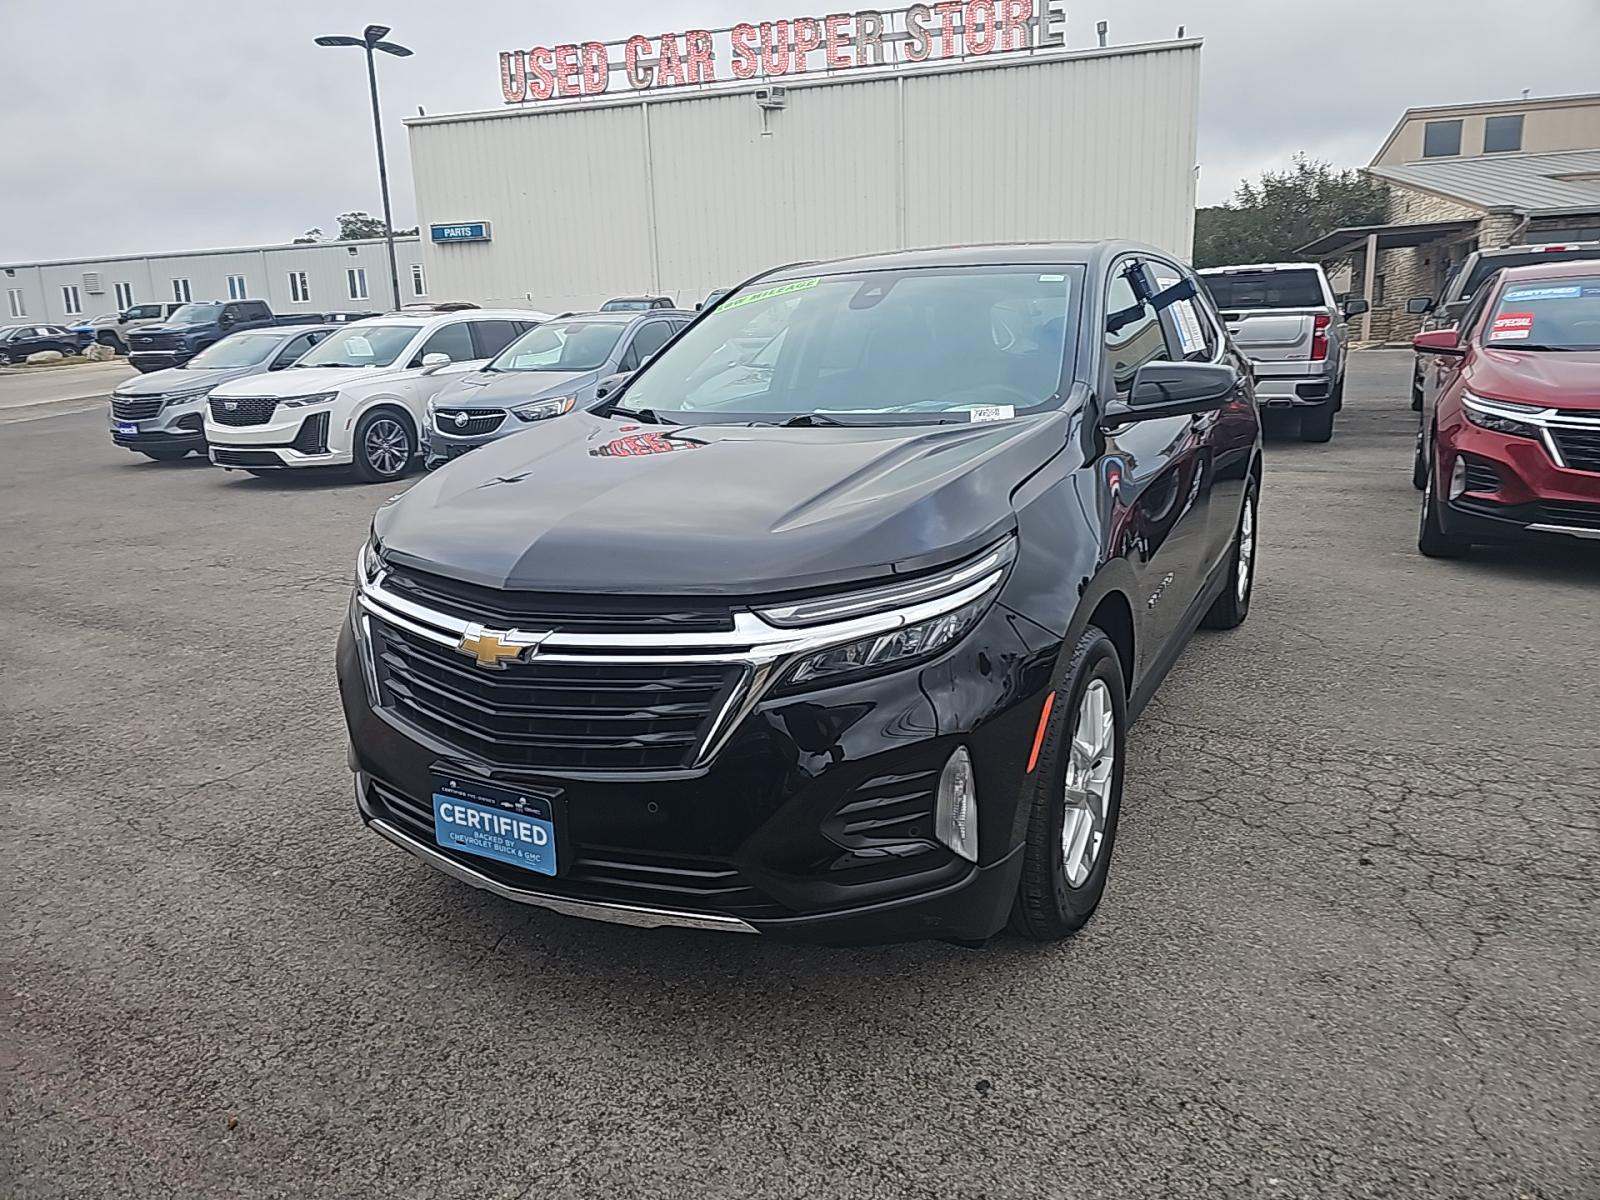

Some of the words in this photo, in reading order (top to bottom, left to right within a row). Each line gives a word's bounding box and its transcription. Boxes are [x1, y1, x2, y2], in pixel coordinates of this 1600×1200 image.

[499, 41, 608, 101] USED
[625, 29, 716, 90] CAR
[731, 10, 884, 79] SUPER
[904, 0, 1066, 62] STORE
[444, 227, 471, 237] PARTS
[439, 802, 547, 846] CERTIFIED
[473, 831, 504, 844] BACKED
[505, 839, 515, 848] BY
[449, 832, 492, 848] CHEVROLET
[493, 843, 517, 856] BUICK
[523, 852, 542, 863] GMC
